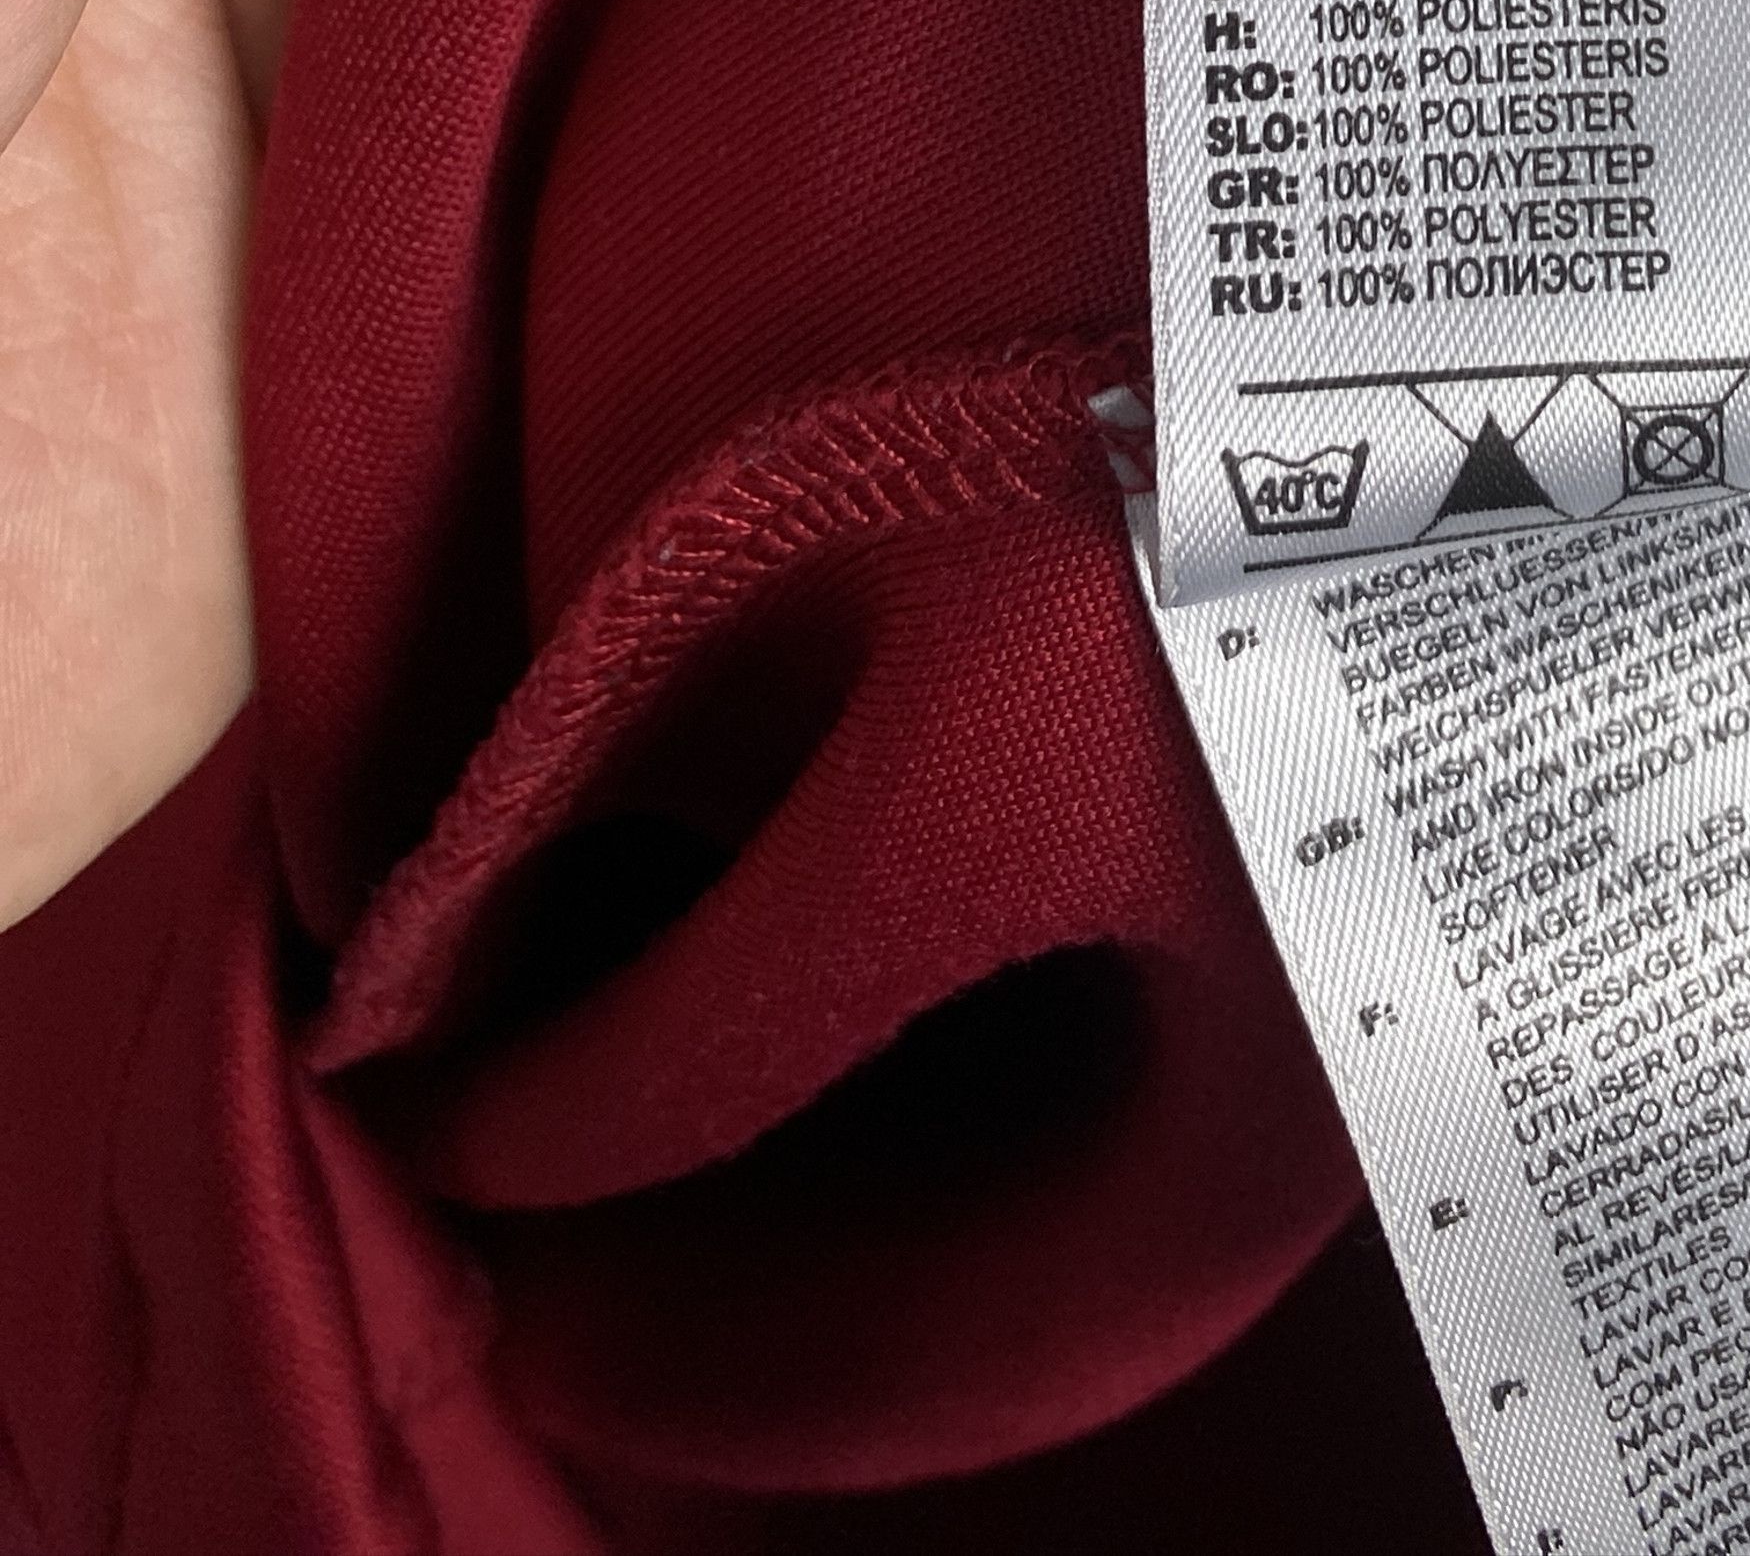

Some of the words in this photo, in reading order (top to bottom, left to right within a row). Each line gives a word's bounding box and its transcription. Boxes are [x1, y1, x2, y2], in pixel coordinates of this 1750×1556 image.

[1205, 13, 1255, 52] H:
[1311, 0, 1403, 42] 100%
[1206, 62, 1294, 104] RO:
[1313, 51, 1406, 94] 100%
[1419, 38, 1668, 87] POLIESTERIS
[1208, 113, 1307, 156] SLO:
[1315, 103, 1408, 148] 100%
[1421, 91, 1635, 140] POLIESTER
[1208, 168, 1298, 209] GR:
[1317, 157, 1410, 200] 100%
[1423, 144, 1654, 193] ΠΟΛΥΕΣΤΕΡ
[1209, 222, 1294, 262] TR:
[1318, 212, 1411, 254] 100%
[1425, 197, 1656, 246] POLYESTER
[1211, 273, 1301, 315] RU:
[1319, 265, 1414, 307] 100%
[1427, 250, 1670, 300] ПОЛИЭСТЕР
[1313, 543, 1494, 619] WASCHEN
[1342, 608, 1509, 693] BUEGELN
[1517, 571, 1591, 619] VON
[1355, 651, 1496, 731] FARBEN
[1371, 627, 1638, 775] WEICHSPUELER
[1384, 748, 1487, 817] WASH
[1405, 802, 1478, 859] AND
[1484, 752, 1566, 815] IRON
[1421, 840, 1500, 902] LIKE
[1438, 825, 1616, 944] SOFTENER
[1453, 895, 1589, 988] LAVAGE
[1591, 839, 1682, 910] AVEC
[1685, 805, 1748, 857] LES
[1503, 893, 1677, 1011] GLISSIERE
[1486, 934, 1693, 1069] REPASSAGE
[1501, 1053, 1575, 1109] DES
[1513, 1048, 1669, 1147] UTILISER
[1523, 1097, 1664, 1185] LAVADO
[1669, 1051, 1744, 1108] CON
[1572, 1226, 1732, 1320] TEXTILES
[1579, 1283, 1691, 1356] LAVAR
[1594, 1314, 1703, 1389] LAVAR
[1604, 1365, 1683, 1422] COM
[1615, 1400, 1689, 1458] NÃO
